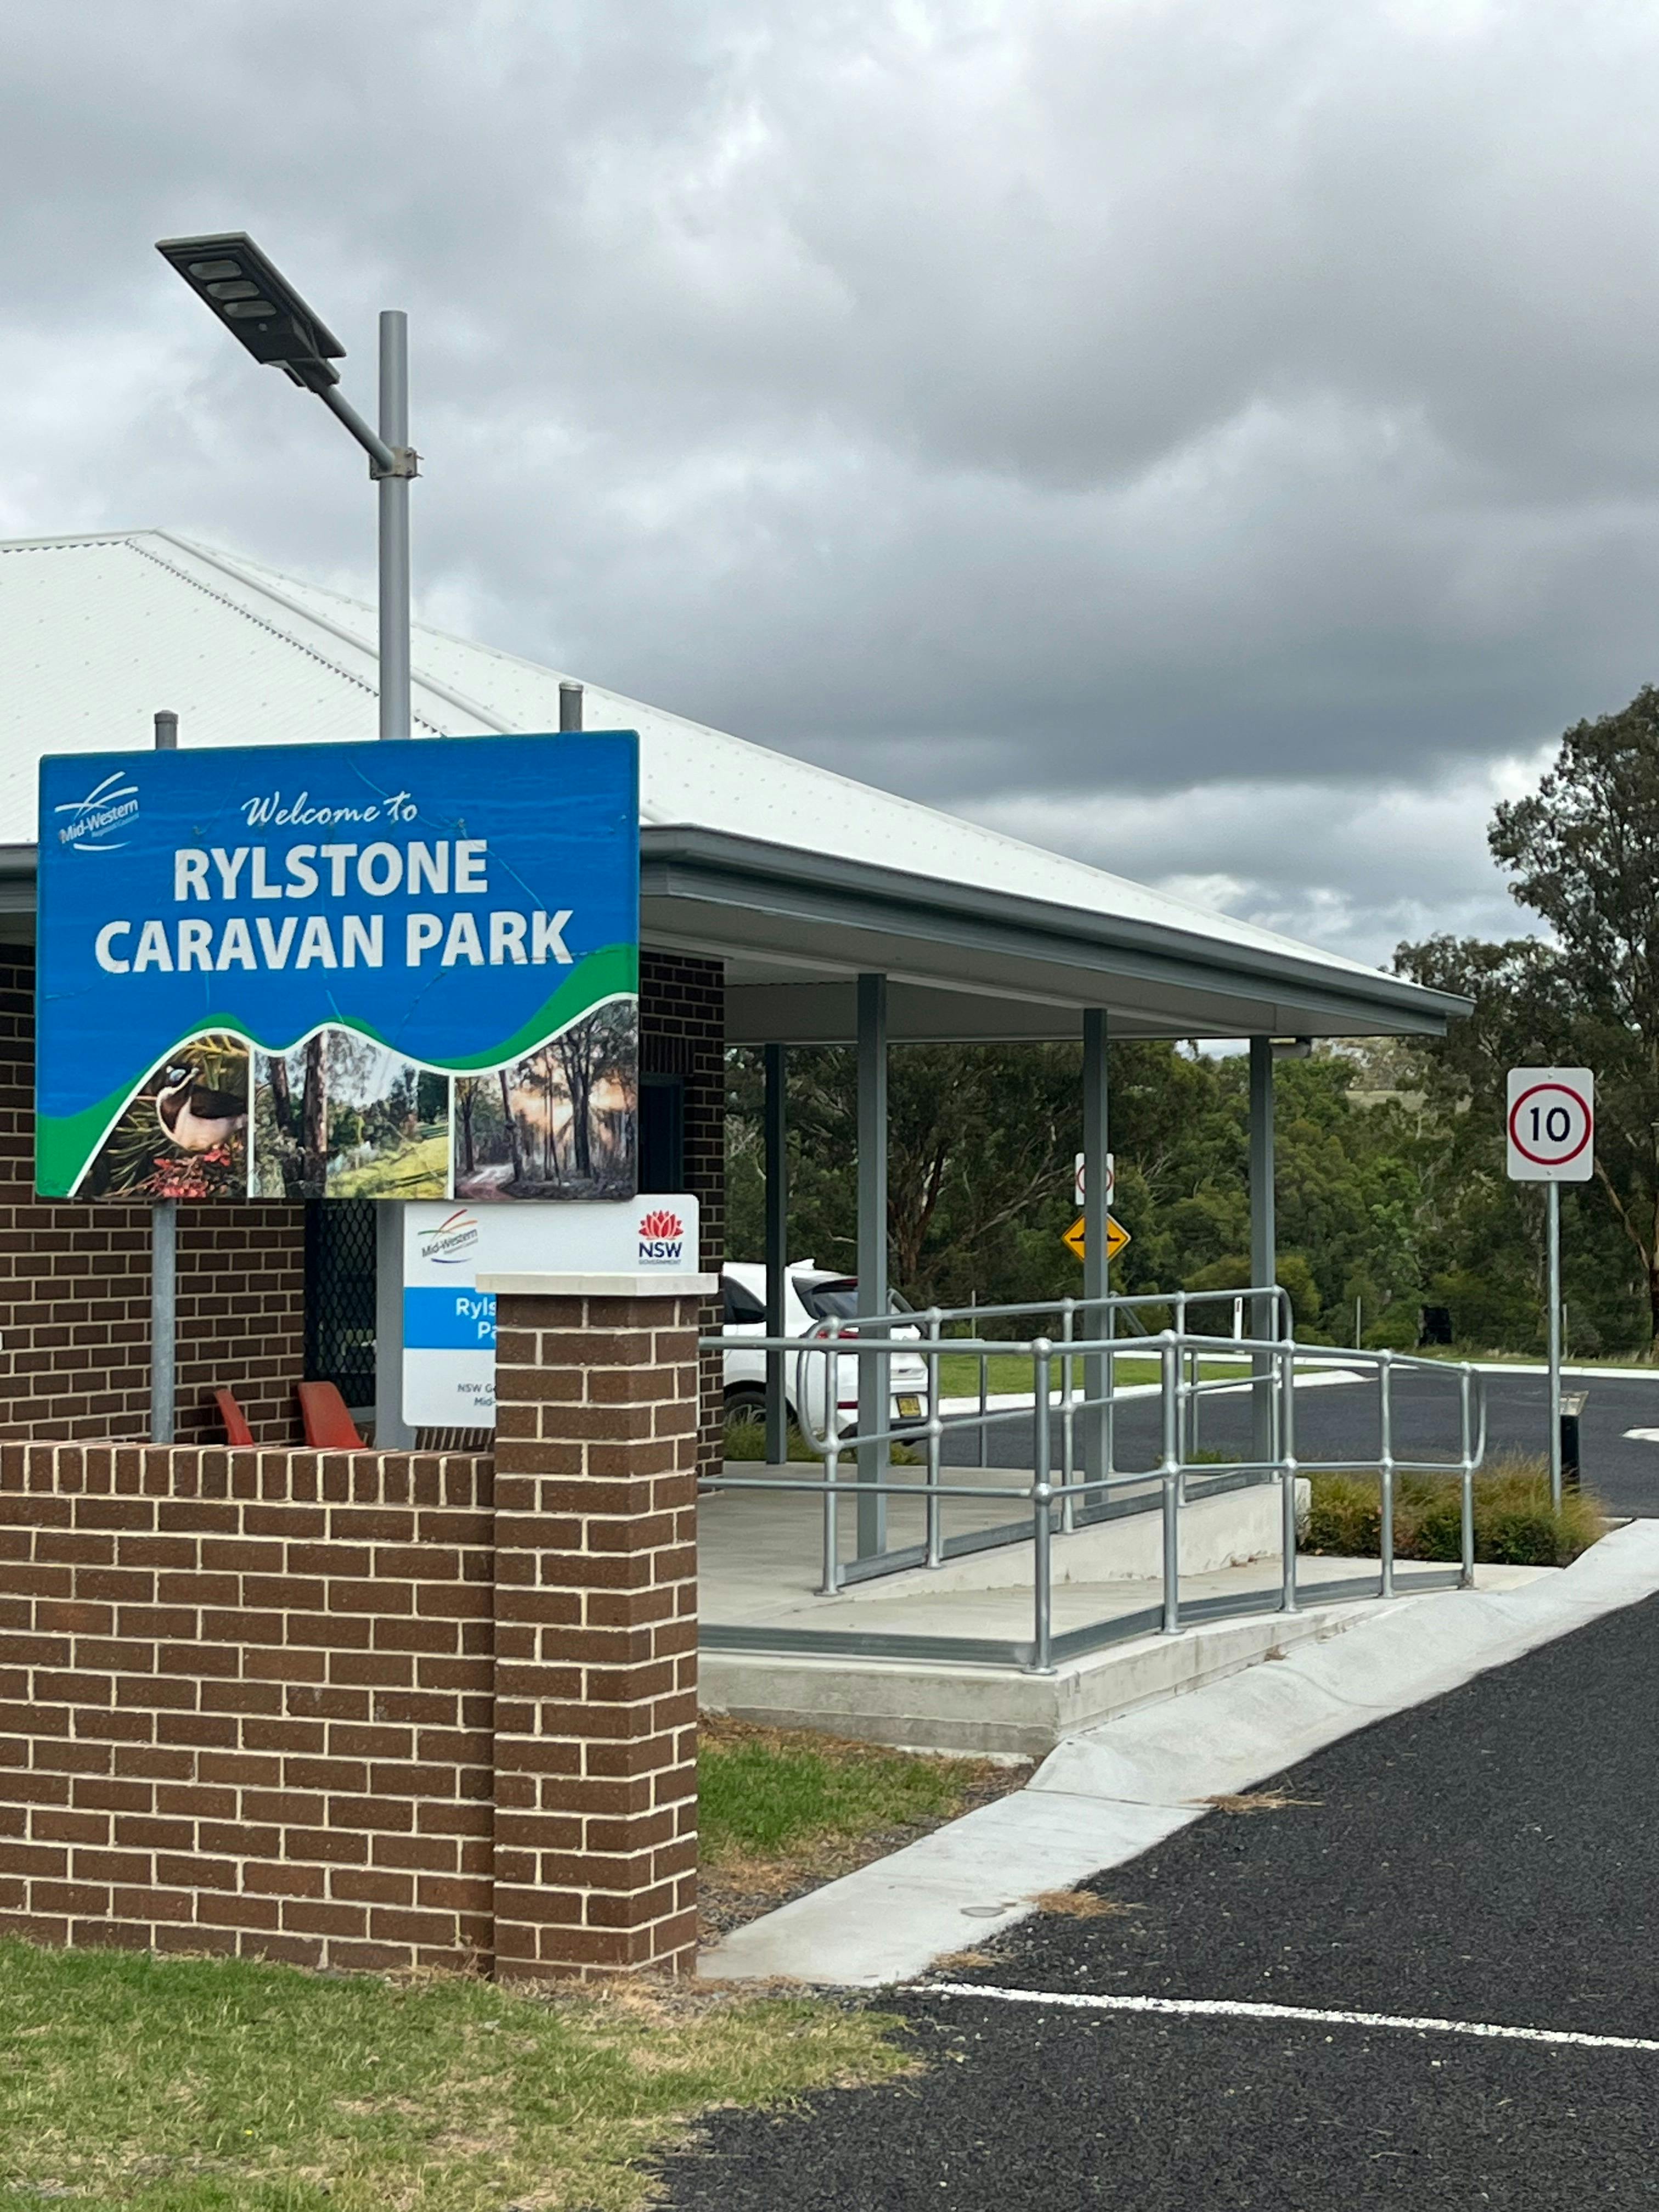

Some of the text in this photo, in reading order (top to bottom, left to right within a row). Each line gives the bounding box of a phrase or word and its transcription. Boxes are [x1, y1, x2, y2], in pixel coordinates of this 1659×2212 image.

[60, 799, 138, 844] Mid-Western
[241, 791, 417, 826] Welcome to
[174, 839, 488, 901] RYLSTONE
[95, 910, 574, 974] CARAVAN PARK
[1530, 1107, 1571, 1142] 10
[422, 1228, 477, 1257] Mid-Western
[639, 1242, 682, 1257] NSW
[458, 1383, 482, 1392] NSW
